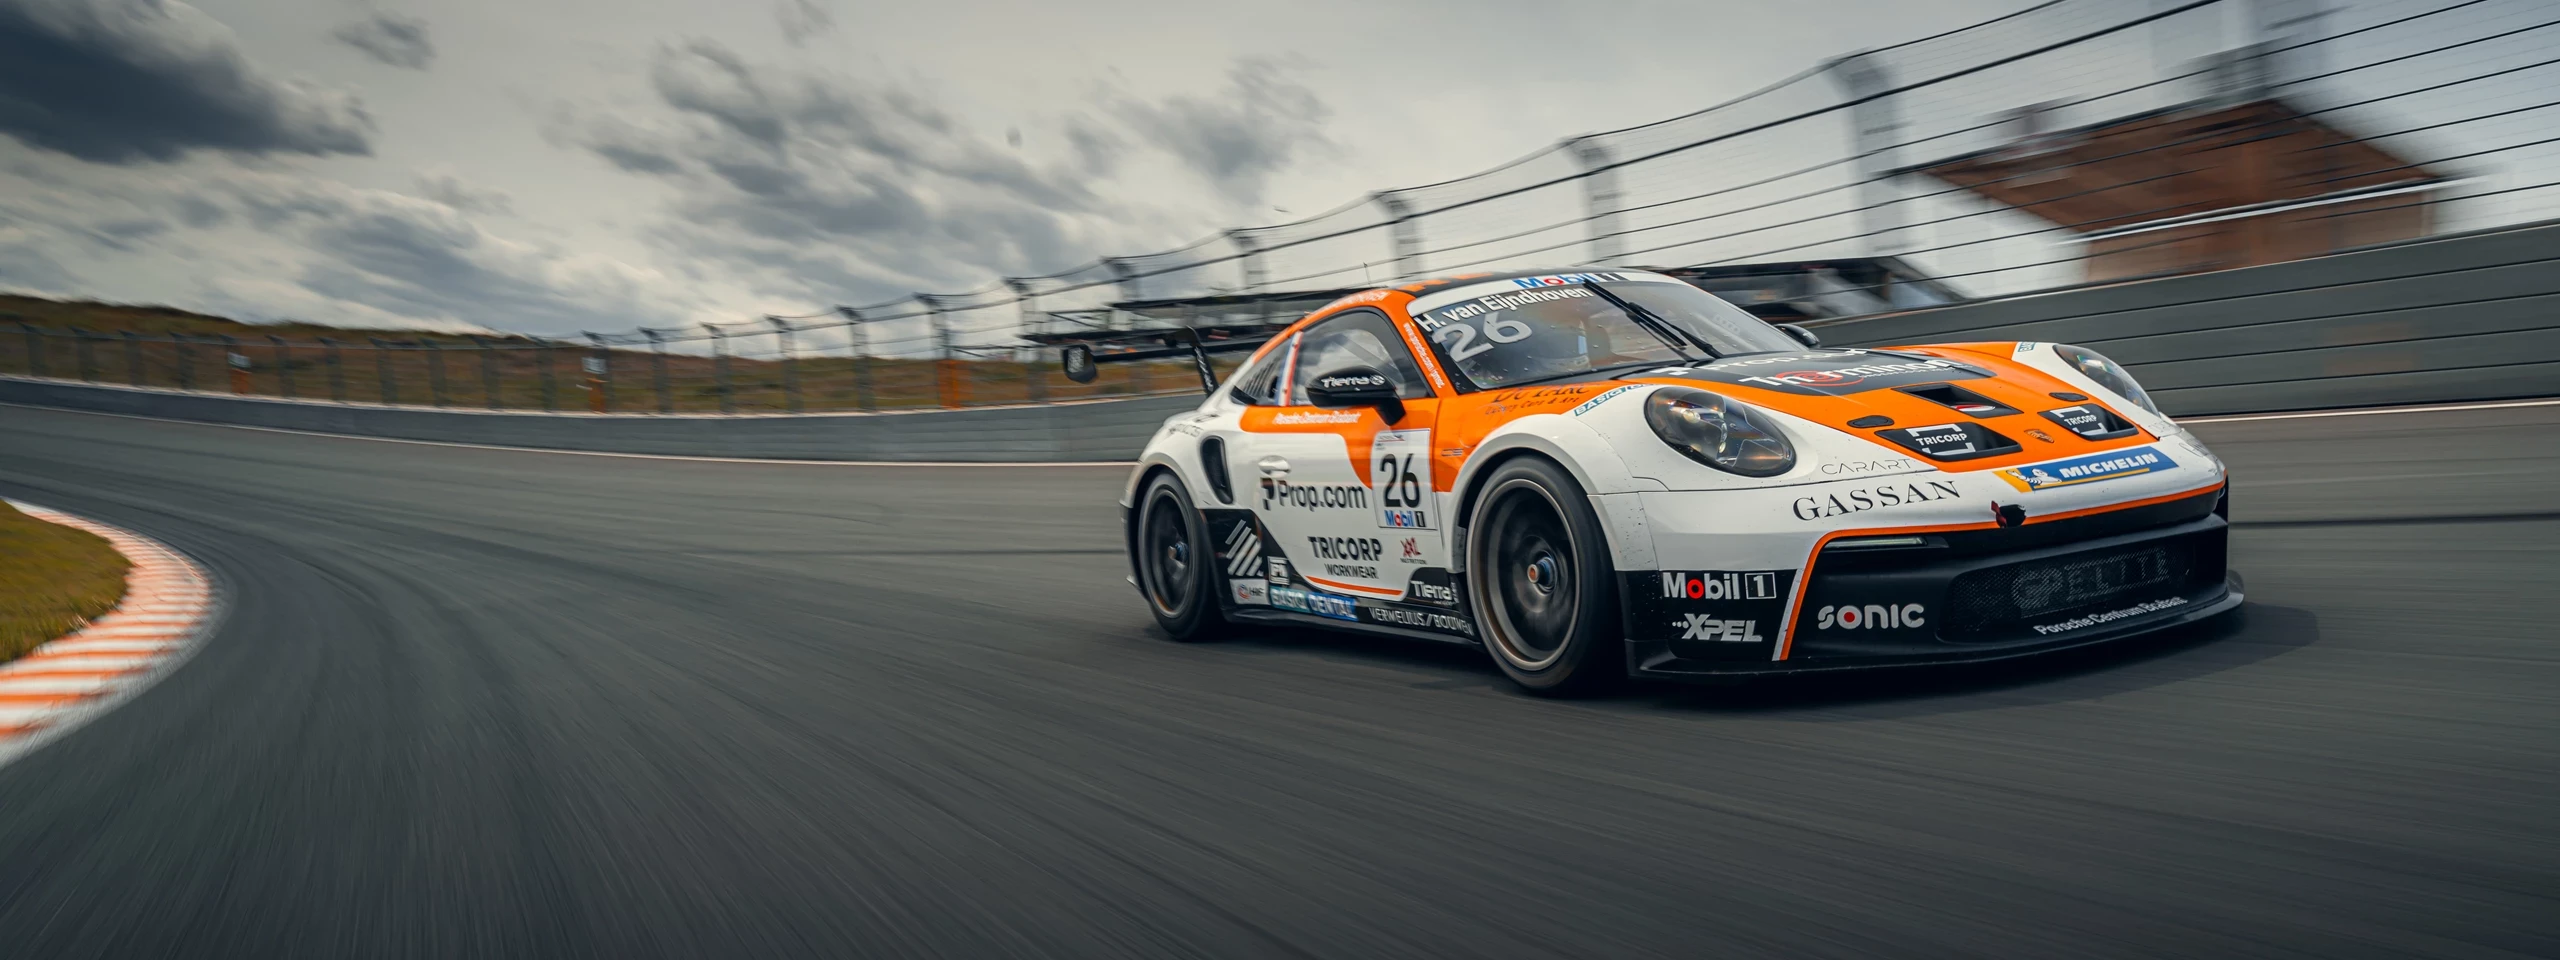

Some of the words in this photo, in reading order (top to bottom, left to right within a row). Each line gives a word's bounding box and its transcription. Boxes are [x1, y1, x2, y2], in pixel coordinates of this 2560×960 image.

[1512, 272, 1597, 289] Mobil
[1414, 314, 1447, 332] H.
[1442, 302, 1484, 322] van
[1479, 286, 1594, 312] Eijndhoven
[1431, 312, 1533, 363] 26
[1321, 375, 1370, 388] Tierra
[2063, 413, 2098, 426] TRICORP
[1915, 432, 1968, 446] TRICORP
[1821, 458, 1913, 475] CARART
[2058, 452, 2160, 479] MICHELIN
[1379, 453, 1421, 509] 26
[1276, 480, 1368, 512] Prop.com
[1792, 480, 1961, 521] GASSAN
[1383, 509, 1415, 527] Mobil
[1307, 536, 1383, 562] TRICORP
[1324, 563, 1379, 579] WORKWEAR
[1410, 580, 1453, 601] Tierra
[1662, 572, 1740, 600] Mobil
[1681, 613, 1763, 642] XPEL
[2032, 616, 2095, 635] Porsche
[2087, 605, 2145, 624] Centrum
